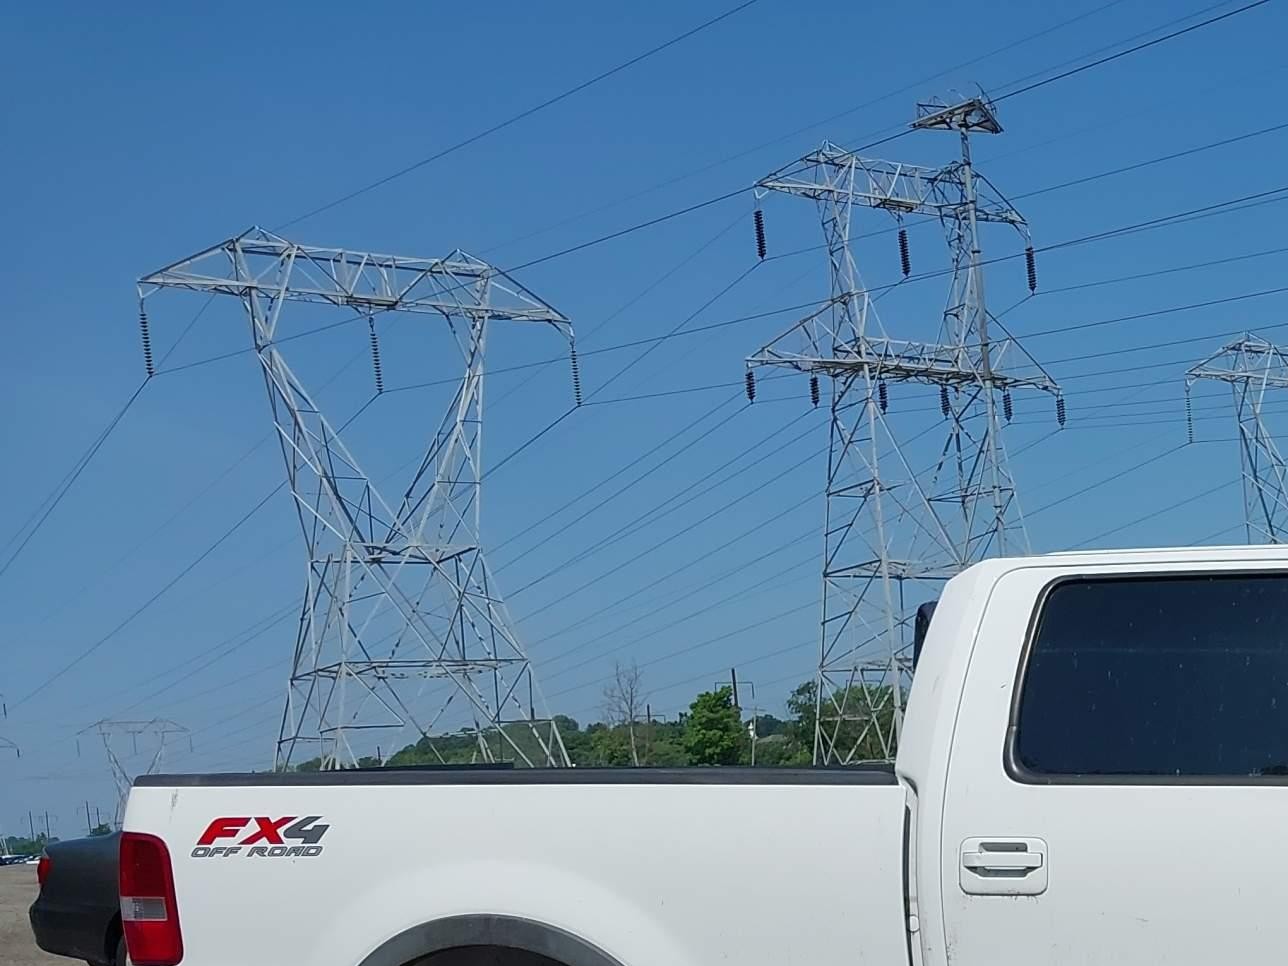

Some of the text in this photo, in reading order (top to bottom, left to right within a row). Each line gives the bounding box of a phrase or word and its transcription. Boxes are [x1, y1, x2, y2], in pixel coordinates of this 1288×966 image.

[197, 816, 330, 845] FX4
[191, 845, 324, 858] OFF ROAD
